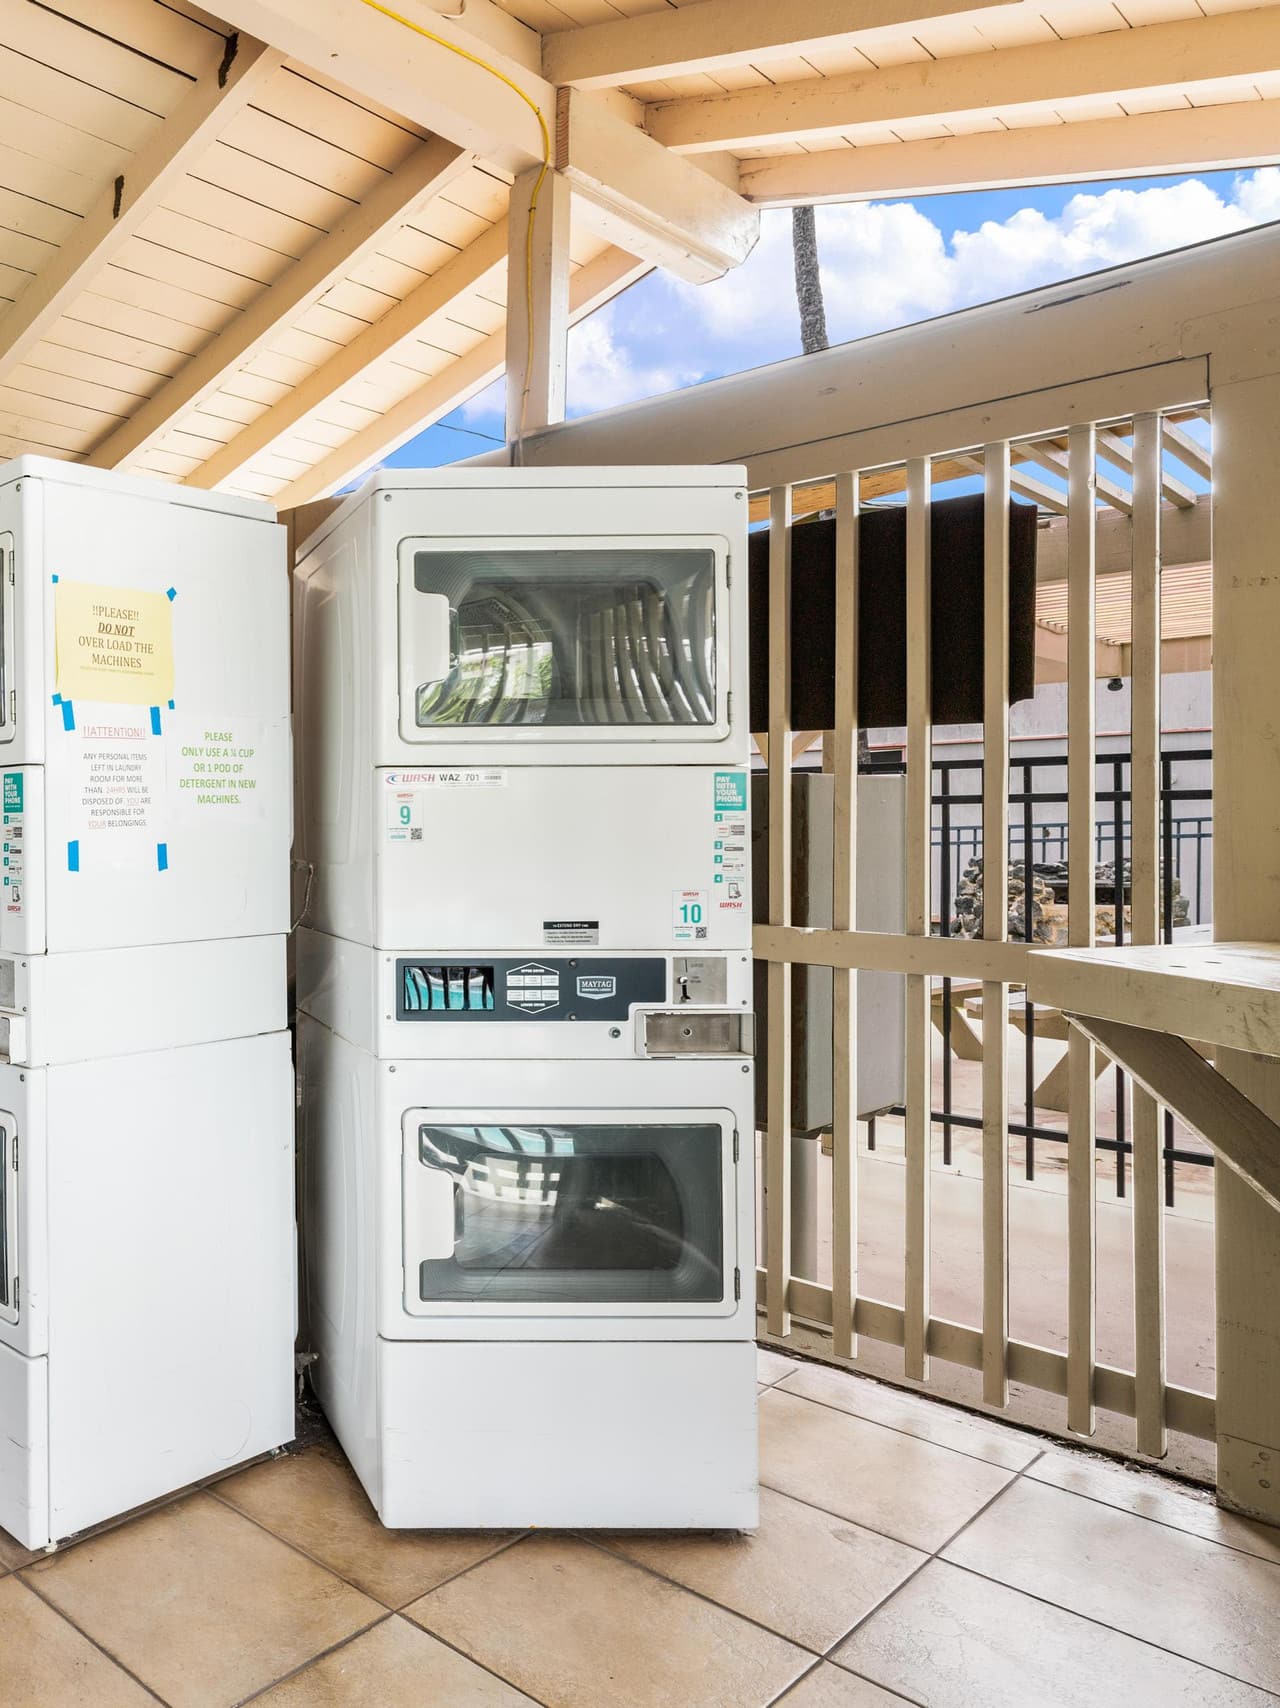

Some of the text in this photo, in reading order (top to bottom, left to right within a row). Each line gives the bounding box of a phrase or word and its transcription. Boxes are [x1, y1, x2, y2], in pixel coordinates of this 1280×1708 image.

[92, 605, 139, 621] !!PLEASE!!
[98, 622, 135, 637] DO NOT
[78, 636, 154, 654] OVER LOAD THE
[92, 653, 142, 668] MACHINES
[204, 731, 233, 742] PLEASE
[131, 753, 148, 761] ITEMS
[181, 746, 204, 757] ONLY
[205, 748, 221, 757] USE
[223, 748, 229, 757] A
[238, 748, 255, 758] CUP
[90, 764, 105, 772] LEFT
[115, 764, 142, 772] LAUNDRY
[193, 763, 244, 773] OR 1 POD OF
[126, 775, 143, 783] MORE
[402, 773, 436, 783] WASH
[439, 773, 461, 782] WAZ
[465, 773, 480, 782] 701
[179, 779, 257, 789] DETERGENT IN NEW
[84, 786, 103, 794] THAN
[127, 786, 141, 794] WILL
[82, 798, 114, 806] DISPOSED
[197, 794, 241, 804] MACHINES.
[90, 808, 132, 816] RESPONSIBLE
[400, 805, 411, 825] 9
[680, 904, 702, 924] 10
[581, 980, 612, 988] MAYTAG
